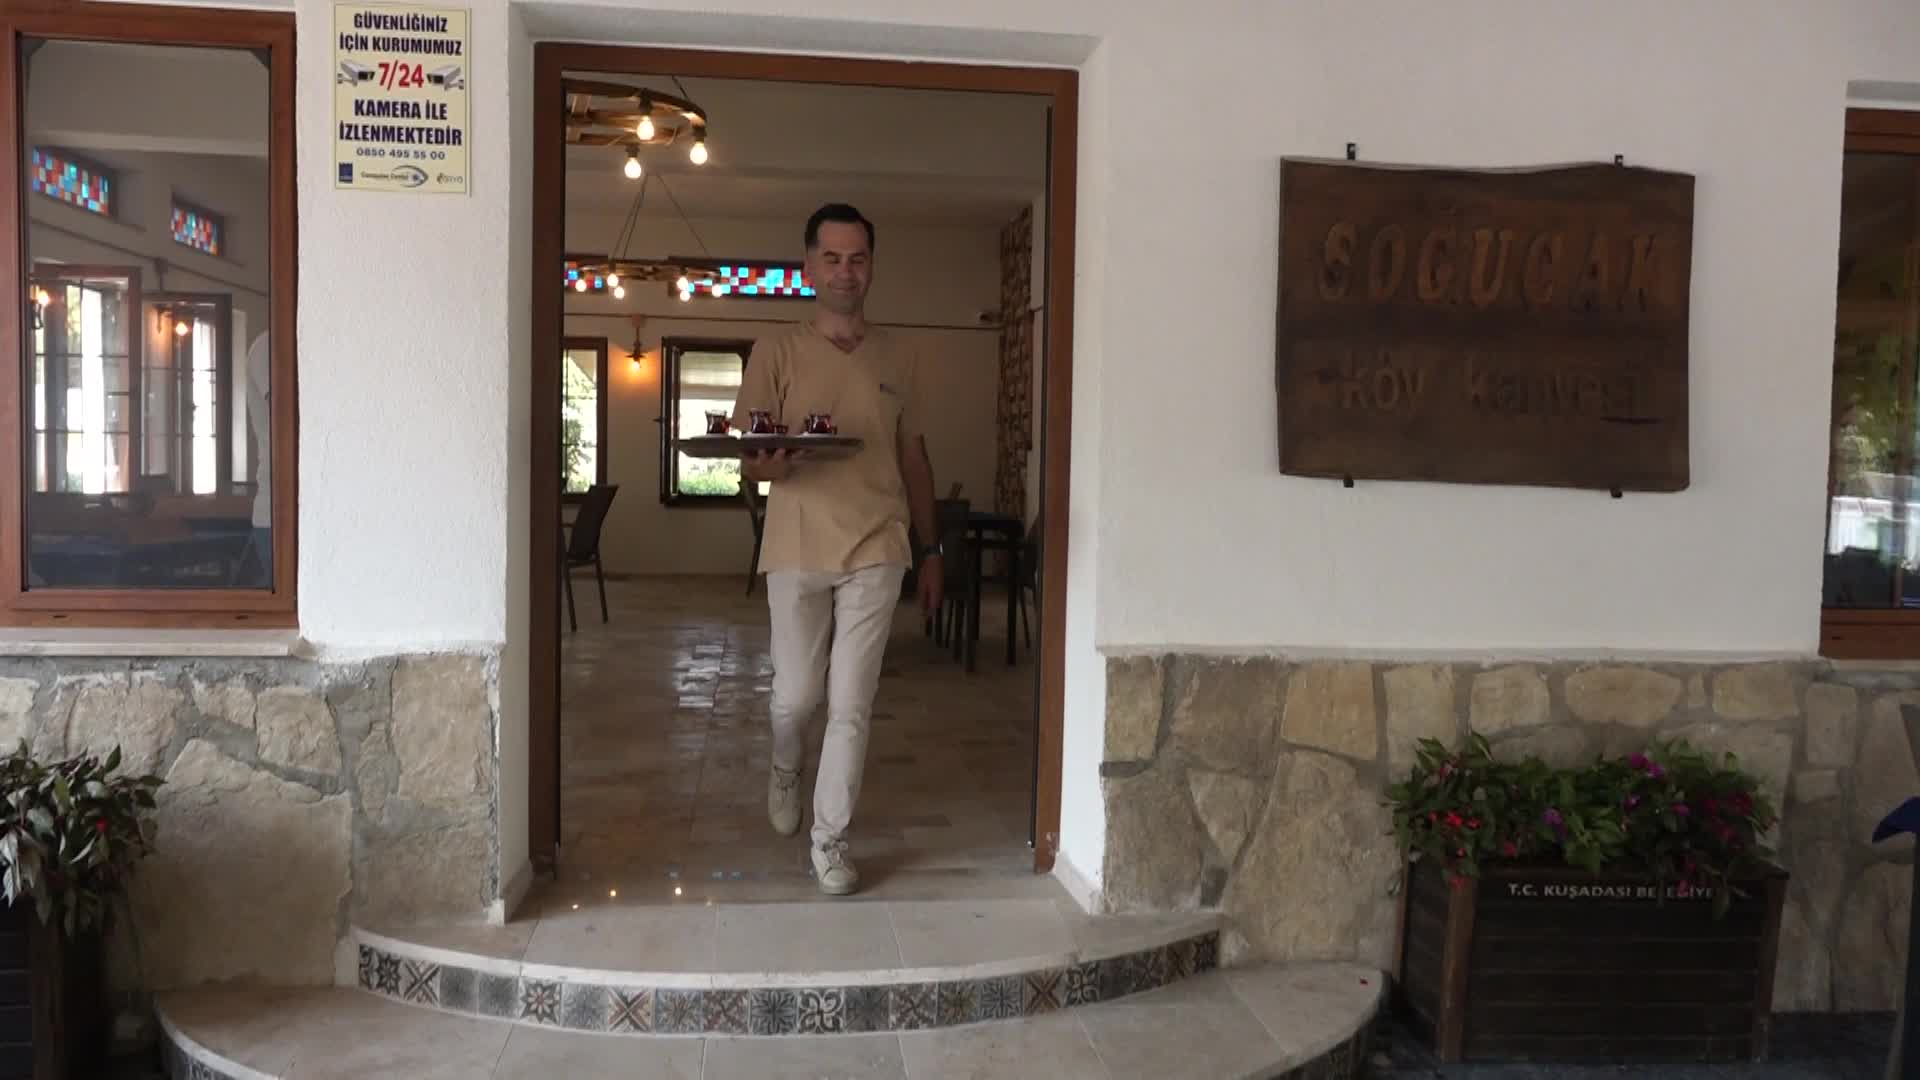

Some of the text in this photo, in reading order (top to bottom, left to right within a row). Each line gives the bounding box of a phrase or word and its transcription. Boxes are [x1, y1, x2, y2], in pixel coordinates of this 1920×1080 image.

[353, 11, 448, 33] GÜVENLİĞİNİZ
[339, 32, 463, 56] İÇİN KURUMUMUZ
[377, 60, 425, 91] 7/24
[354, 99, 448, 121] KAMERA İLE
[339, 120, 463, 146] İZLENMEKTEDİR
[356, 147, 446, 161] 0850 495 55 00
[1507, 883, 1538, 897] T.C.
[1543, 885, 1632, 900] KUŞADASI
